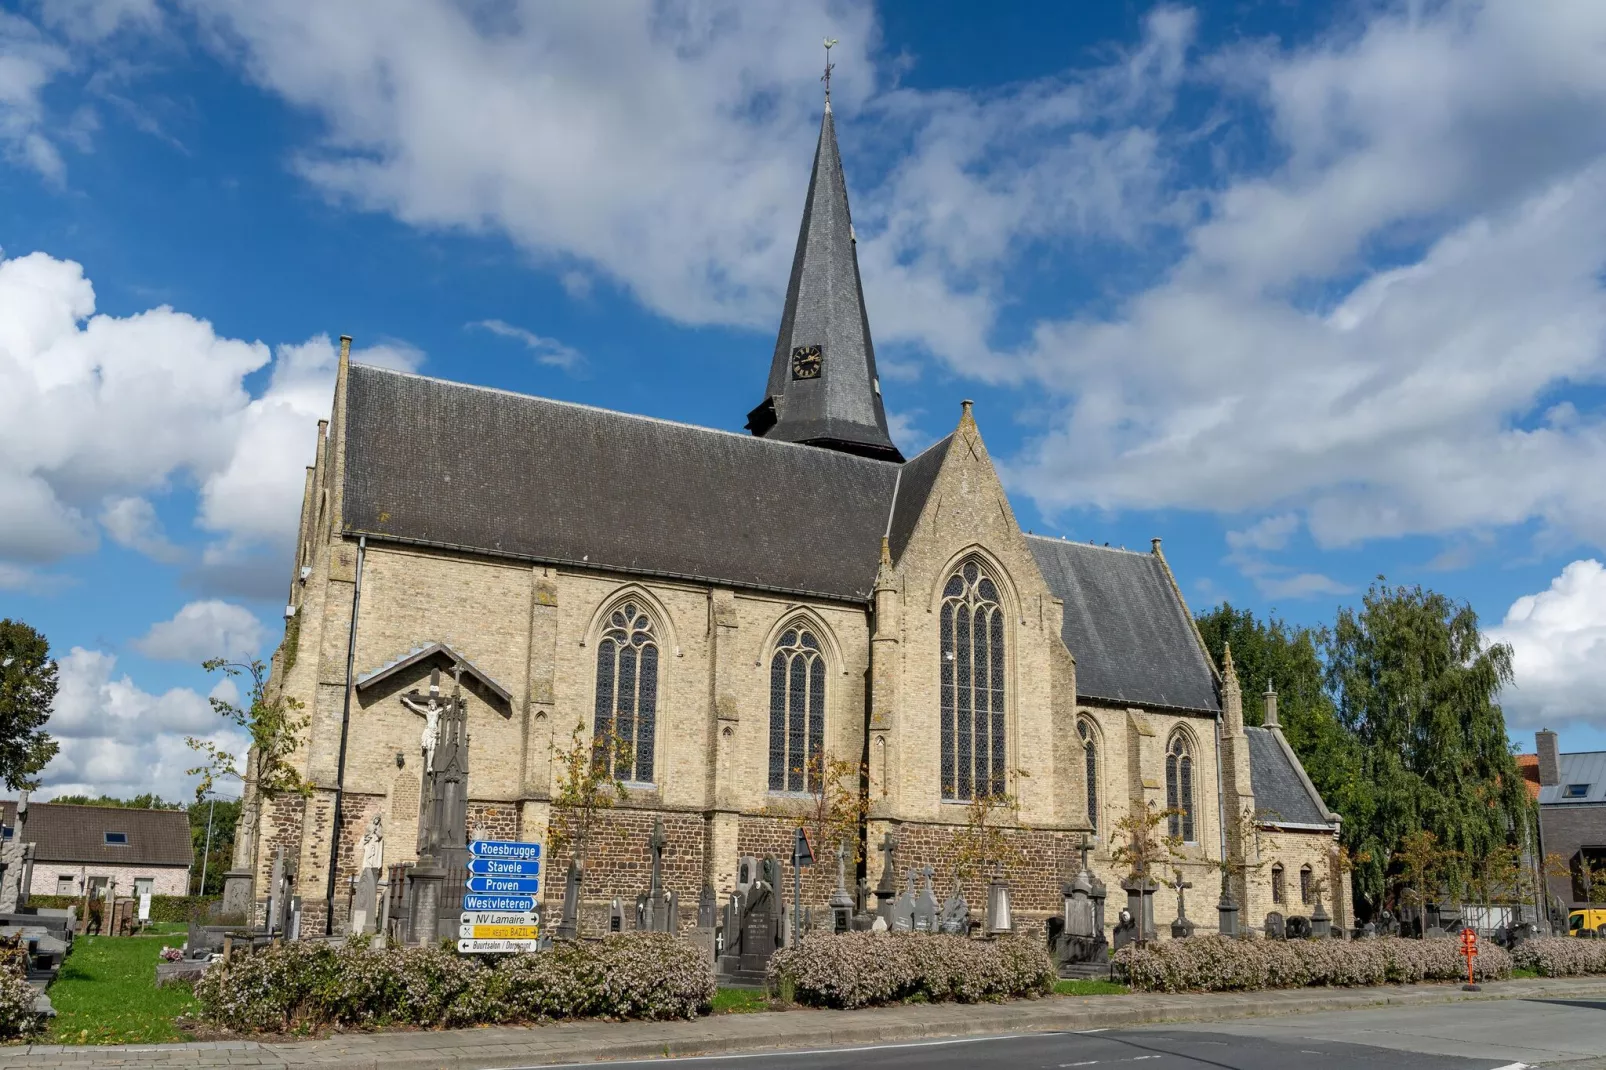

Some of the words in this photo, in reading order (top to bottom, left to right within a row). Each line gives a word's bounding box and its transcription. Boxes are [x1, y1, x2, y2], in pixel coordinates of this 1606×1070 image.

[481, 843, 536, 858] Roesbrugge
[487, 861, 522, 873] Stavele
[485, 879, 519, 891] Proven
[467, 897, 530, 909] Westvleteren
[475, 914, 490, 924] NV
[490, 914, 525, 924] Lamaire
[510, 927, 529, 937] BAZIL
